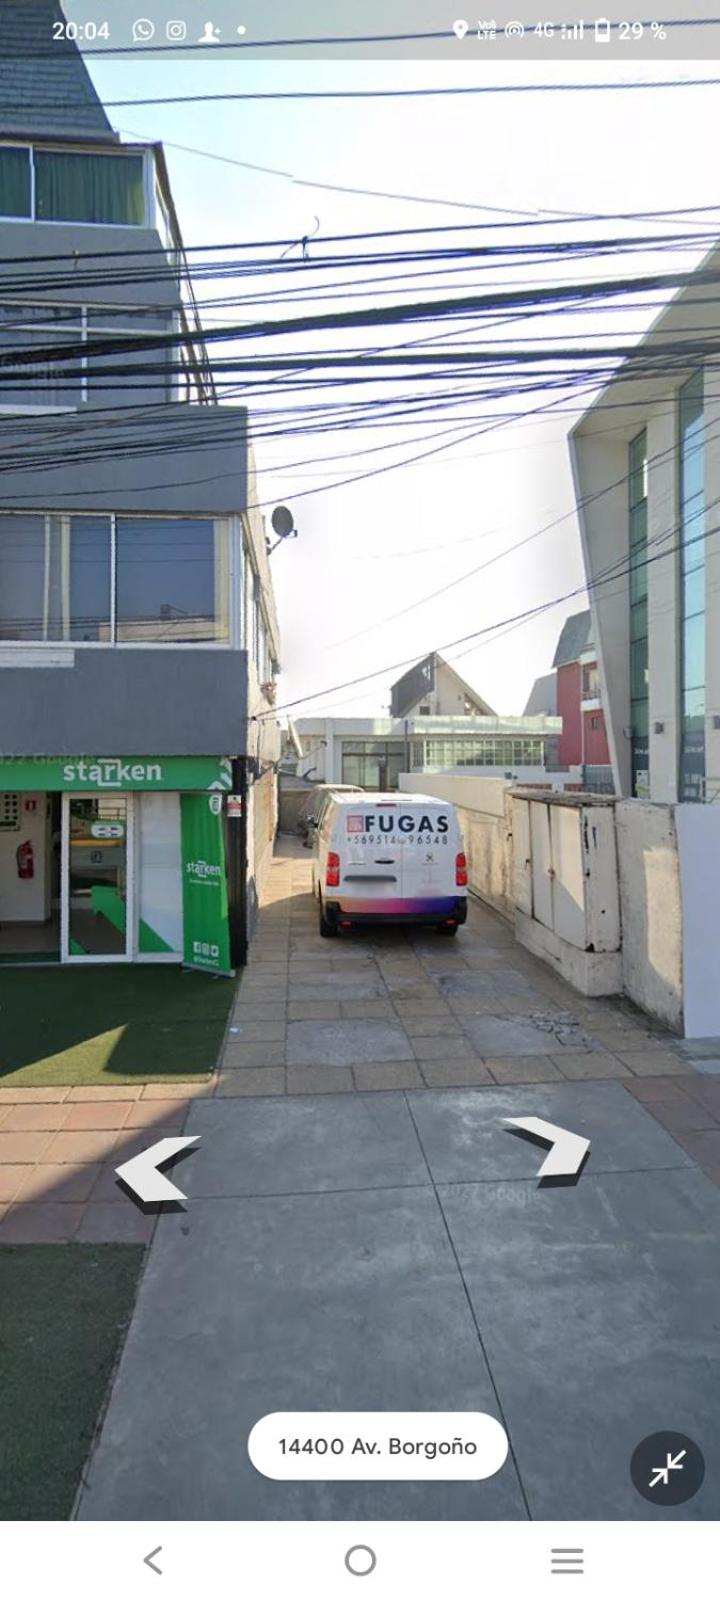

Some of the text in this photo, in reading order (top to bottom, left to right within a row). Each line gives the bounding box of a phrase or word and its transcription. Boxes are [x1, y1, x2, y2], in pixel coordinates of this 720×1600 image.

[63, 760, 162, 785] starken
[365, 815, 449, 833] FUGAS
[186, 861, 221, 878] starken
